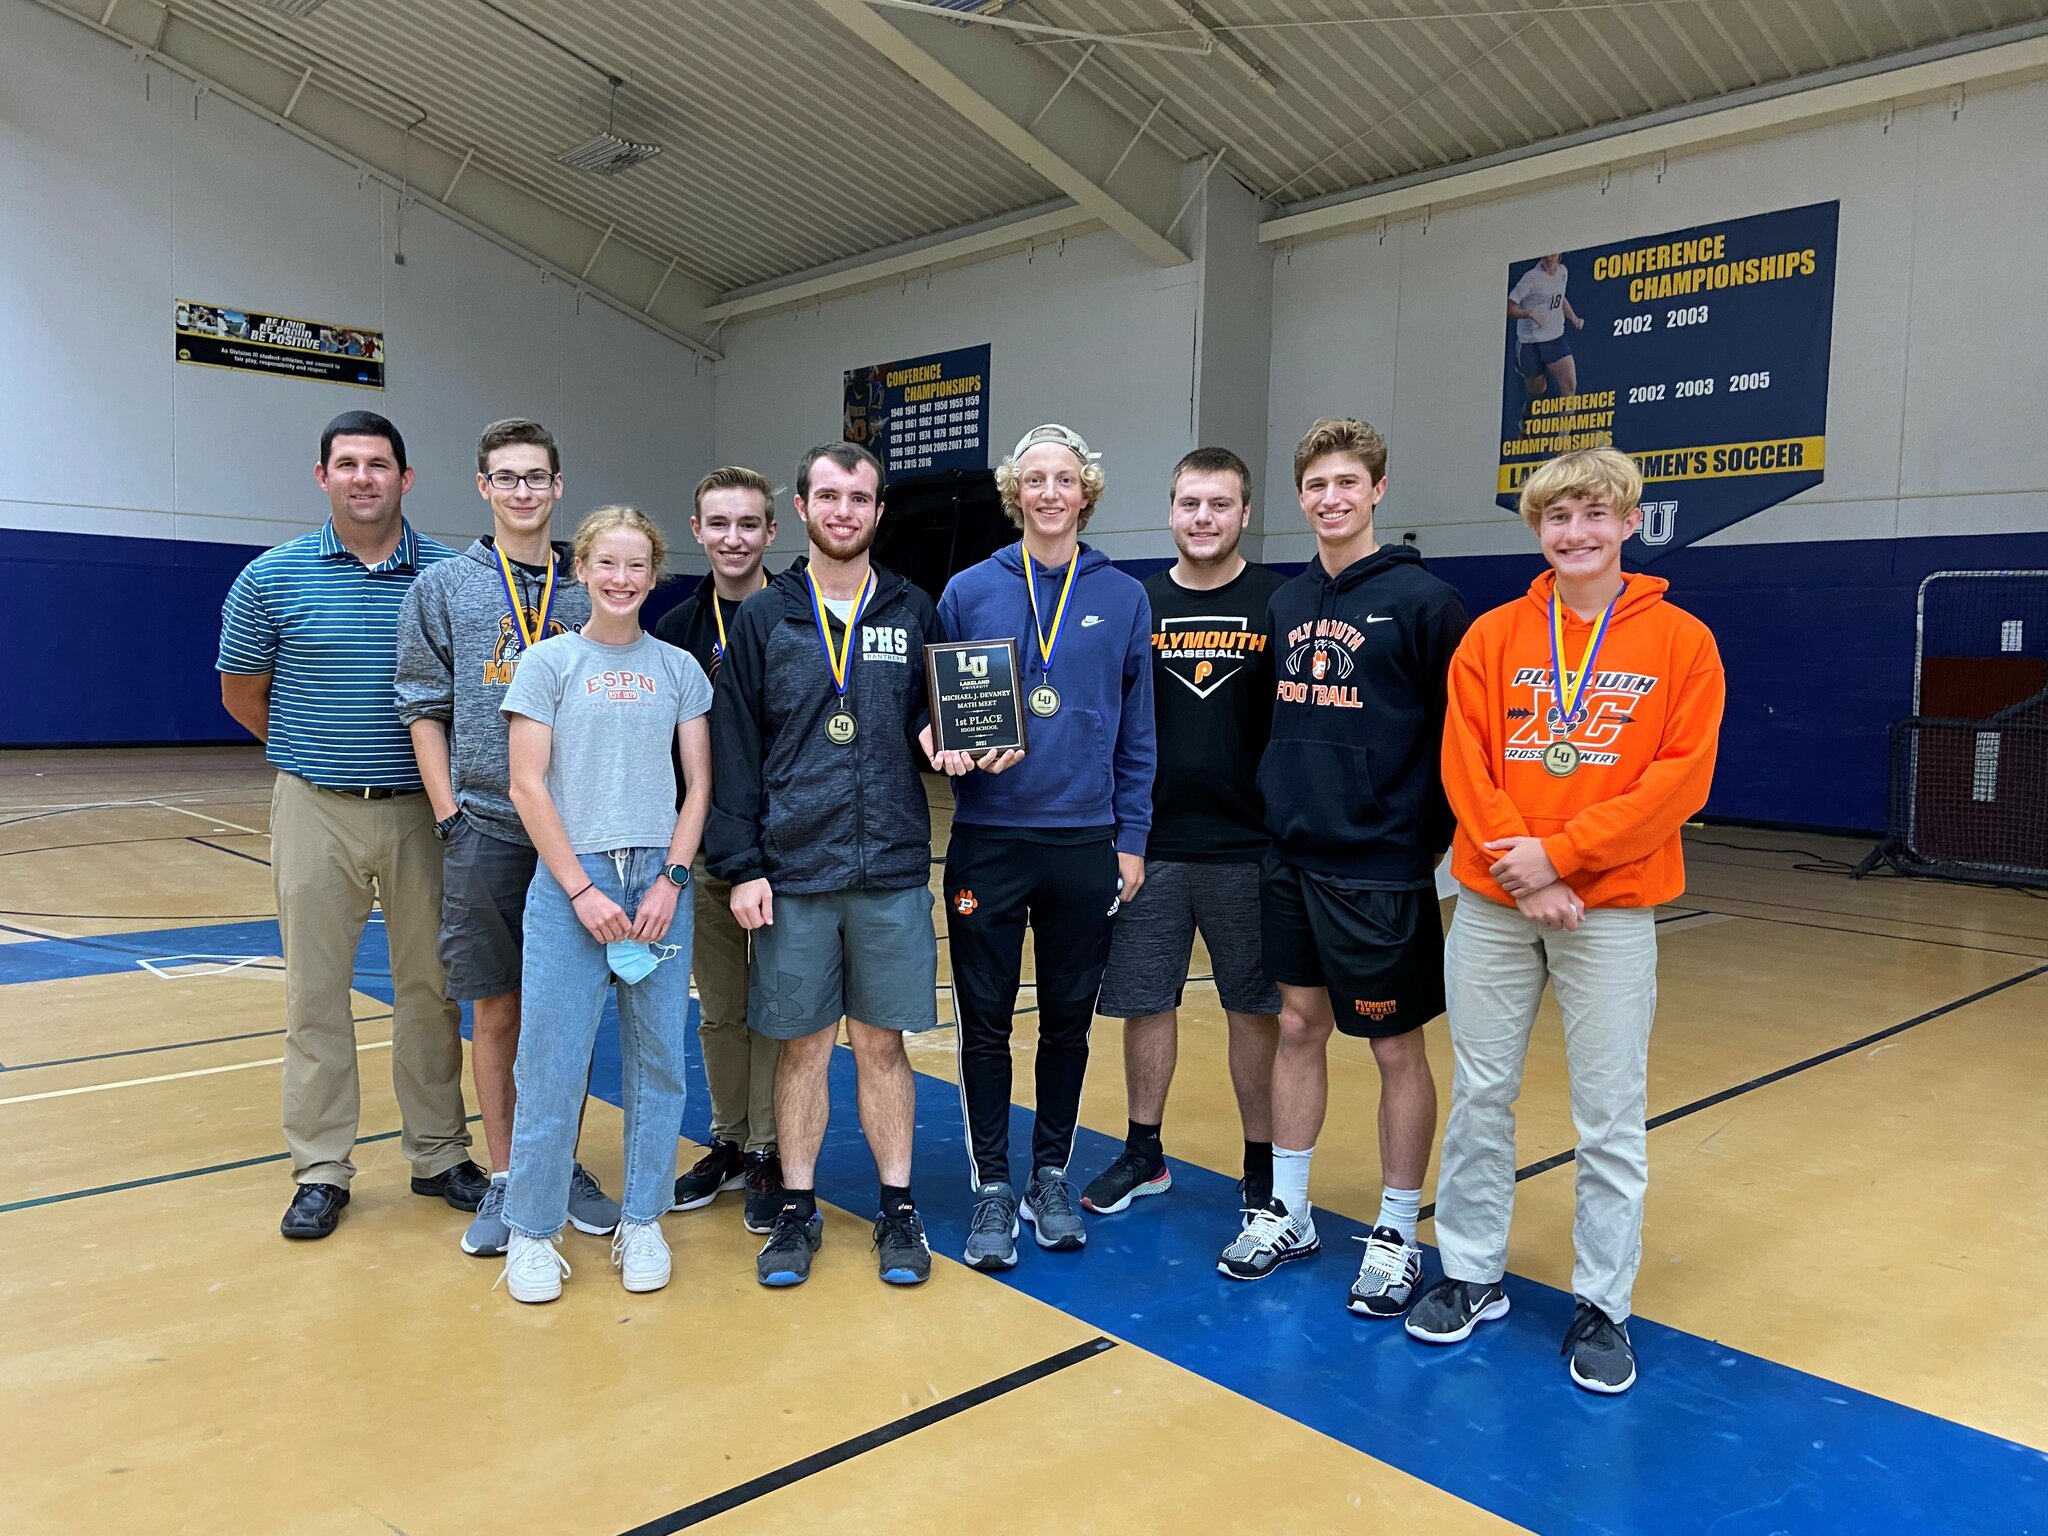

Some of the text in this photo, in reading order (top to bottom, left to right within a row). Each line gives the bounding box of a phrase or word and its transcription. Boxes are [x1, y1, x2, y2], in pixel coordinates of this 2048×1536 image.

[1593, 234, 1726, 281] CONFERENCE
[1629, 248, 1816, 303] CHAMPIONSHIPS
[1549, 294, 1562, 311] 18
[276, 326, 312, 339] PROUD
[1612, 305, 1709, 337] 2002 2003
[250, 329, 321, 350] BE POSITIVE
[886, 363, 942, 388] CONFERENCE
[1629, 371, 1770, 404] 2002 2003 2005
[904, 375, 981, 403] CHAMPIONSHIPS
[1531, 390, 1616, 416] CONFERENCE
[1525, 410, 1615, 435] TOURNAMENT
[1502, 430, 1613, 457] CHAMPIONSHIPS
[1634, 442, 1804, 478] OMEN'S SOCCER
[1635, 500, 1678, 546] U
[862, 625, 908, 654] PHS
[1151, 631, 1267, 652] PLYMOUTH
[866, 654, 904, 662] PANTHERS
[956, 651, 988, 677] LU
[1161, 649, 1245, 660] BASEBALL
[584, 670, 657, 696] ESPN
[960, 679, 990, 687] LAKELAND
[1194, 660, 1213, 685] P
[1511, 667, 1659, 695] PLUTH
[941, 689, 1011, 702] MICHAEL J. DEVANEY
[978, 700, 997, 708] MEET
[1037, 692, 1052, 705] LU
[1276, 680, 1364, 708] FOOTBALL
[834, 718, 849, 731] LU
[954, 714, 1004, 727] 1st PLACE
[976, 724, 999, 732] SCHOOL
[1553, 747, 1571, 763] LU
[1579, 751, 1620, 765] NTRY
